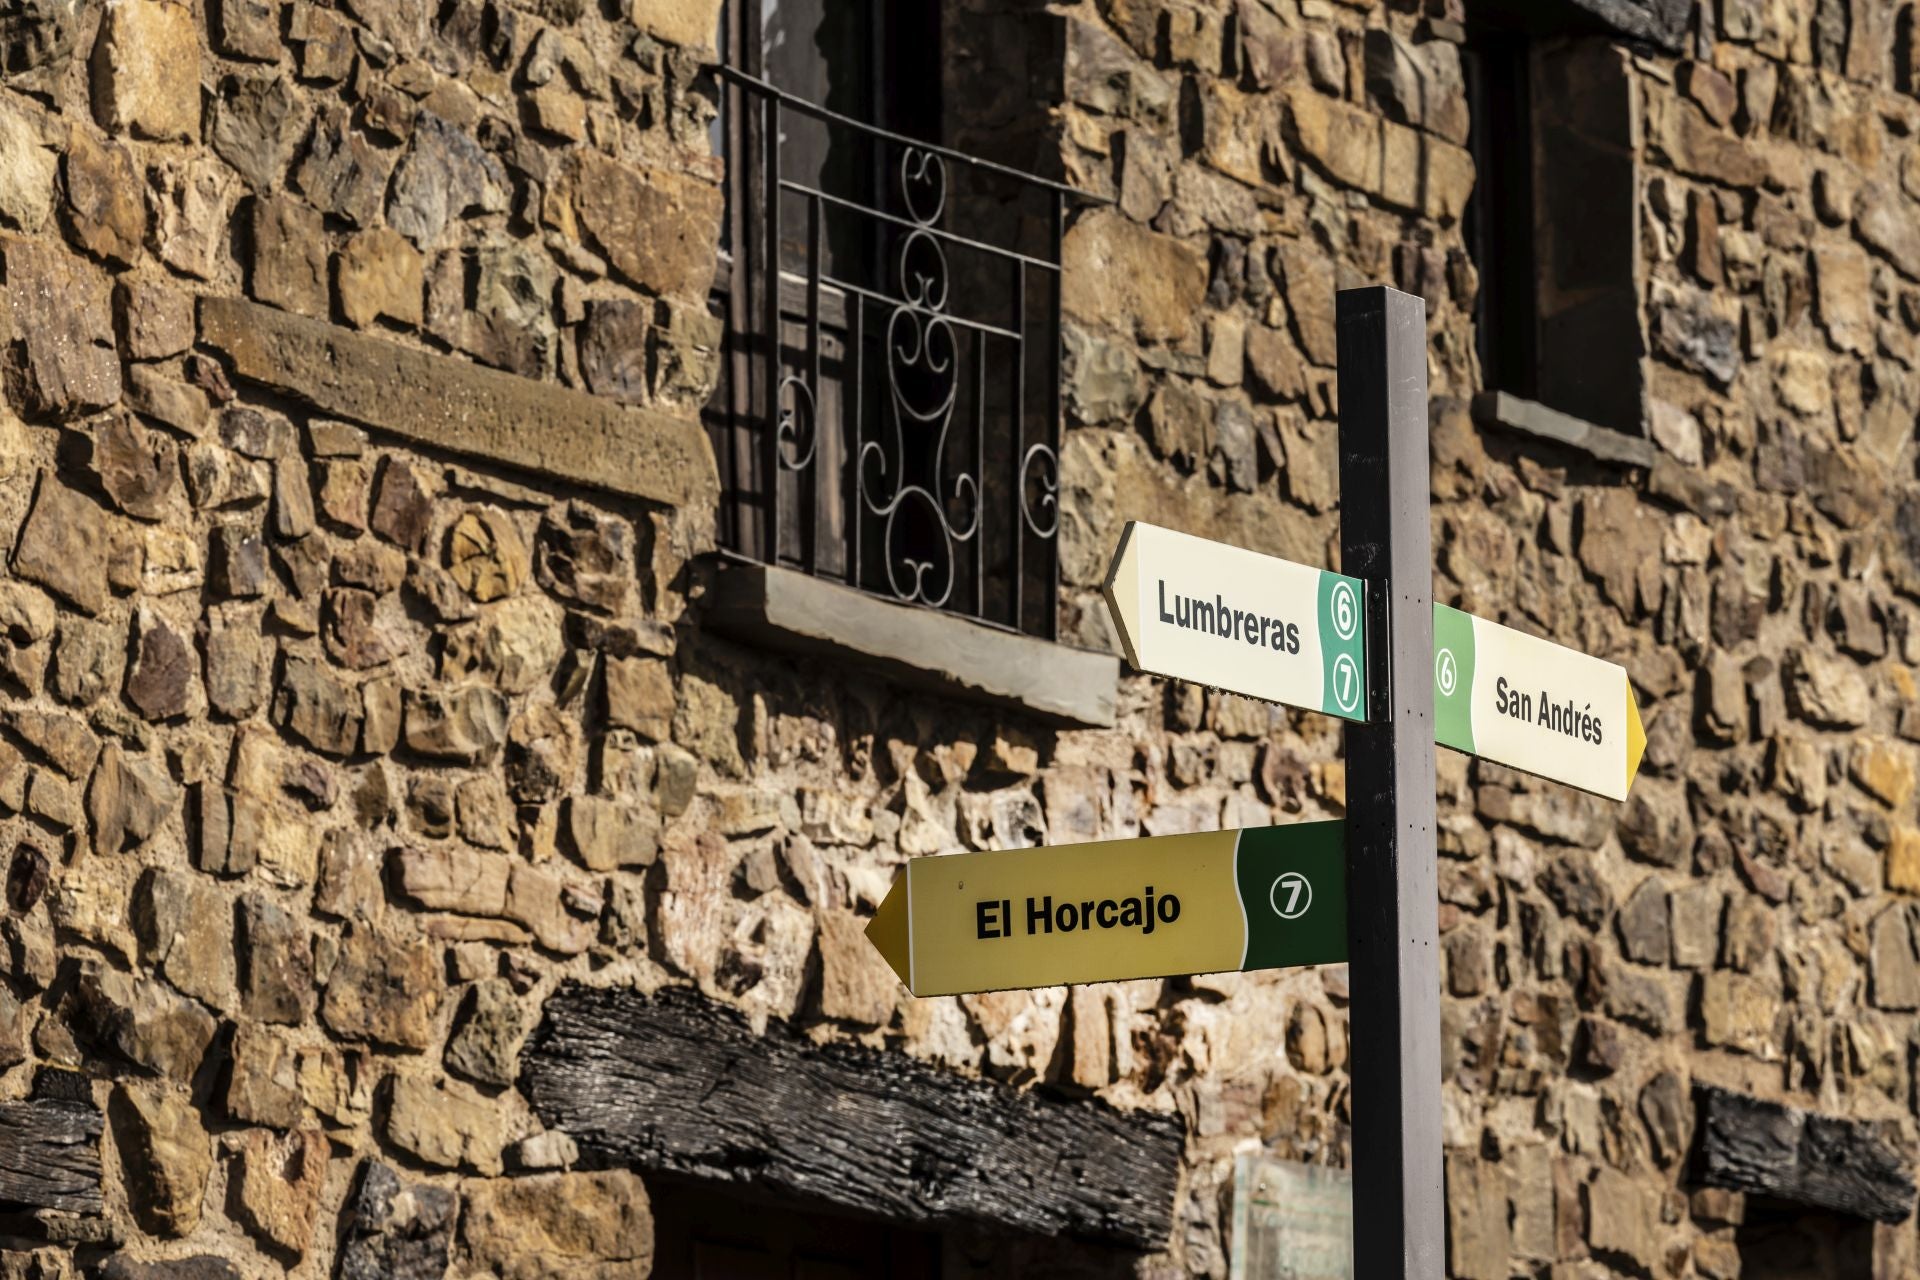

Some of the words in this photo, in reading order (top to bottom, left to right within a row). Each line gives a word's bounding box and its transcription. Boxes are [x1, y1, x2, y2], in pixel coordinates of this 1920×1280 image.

[1158, 579, 1300, 655] Lumbreras
[1337, 590, 1351, 631] 6
[1340, 663, 1352, 702] 7
[1441, 656, 1453, 690] 6
[1495, 676, 1532, 723] San
[1537, 690, 1602, 745] Andrés
[976, 899, 1011, 940] El
[1026, 885, 1181, 935] Horcajo
[1281, 880, 1302, 913] 7
